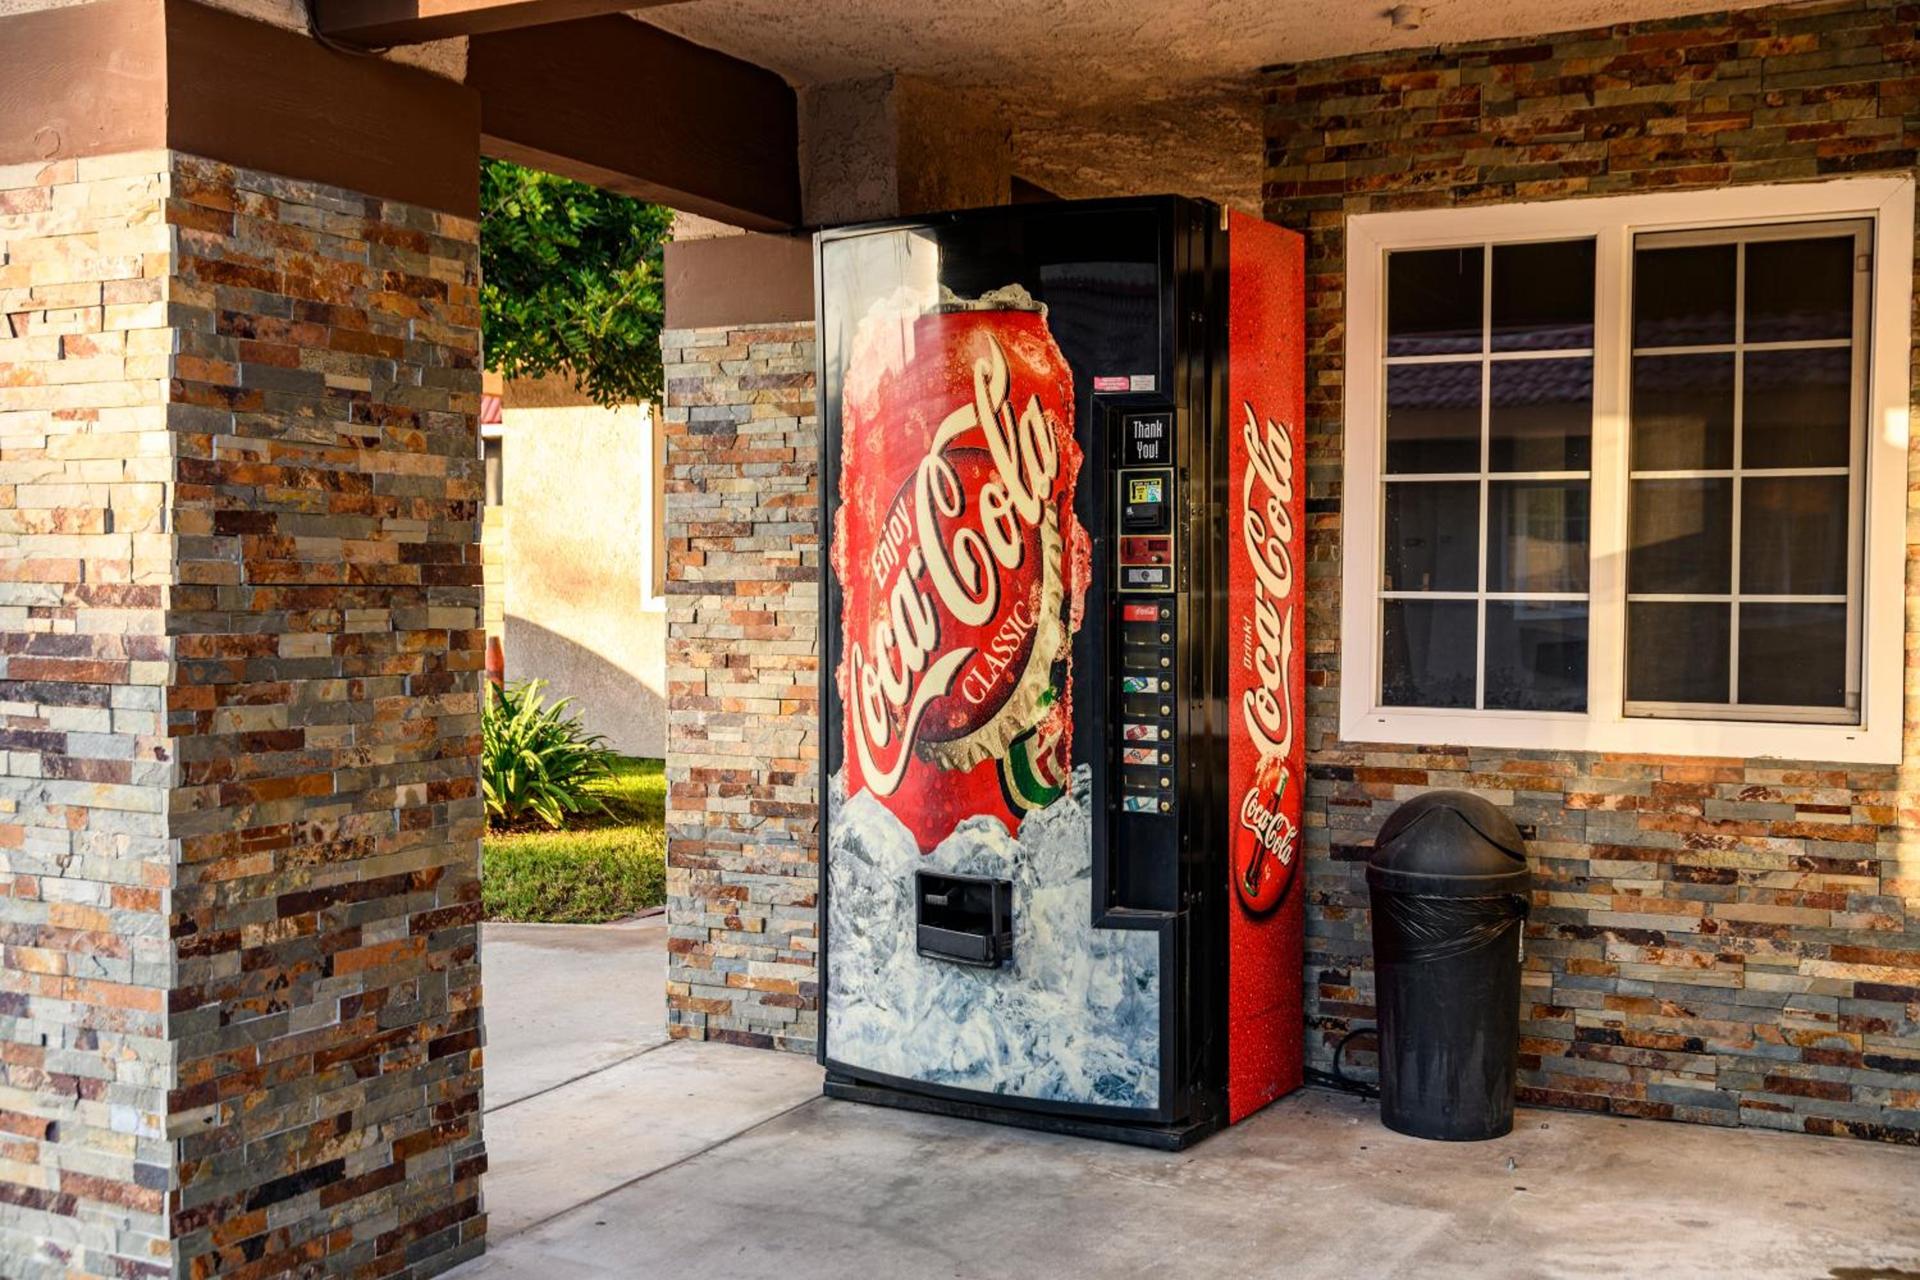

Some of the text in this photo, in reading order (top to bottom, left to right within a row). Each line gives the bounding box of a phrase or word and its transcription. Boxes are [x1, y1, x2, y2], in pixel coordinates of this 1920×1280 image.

[1133, 419, 1163, 439] Thank
[1136, 440, 1159, 460] You!
[871, 496, 912, 590] Enjoy
[962, 601, 1035, 704] CLASSIC
